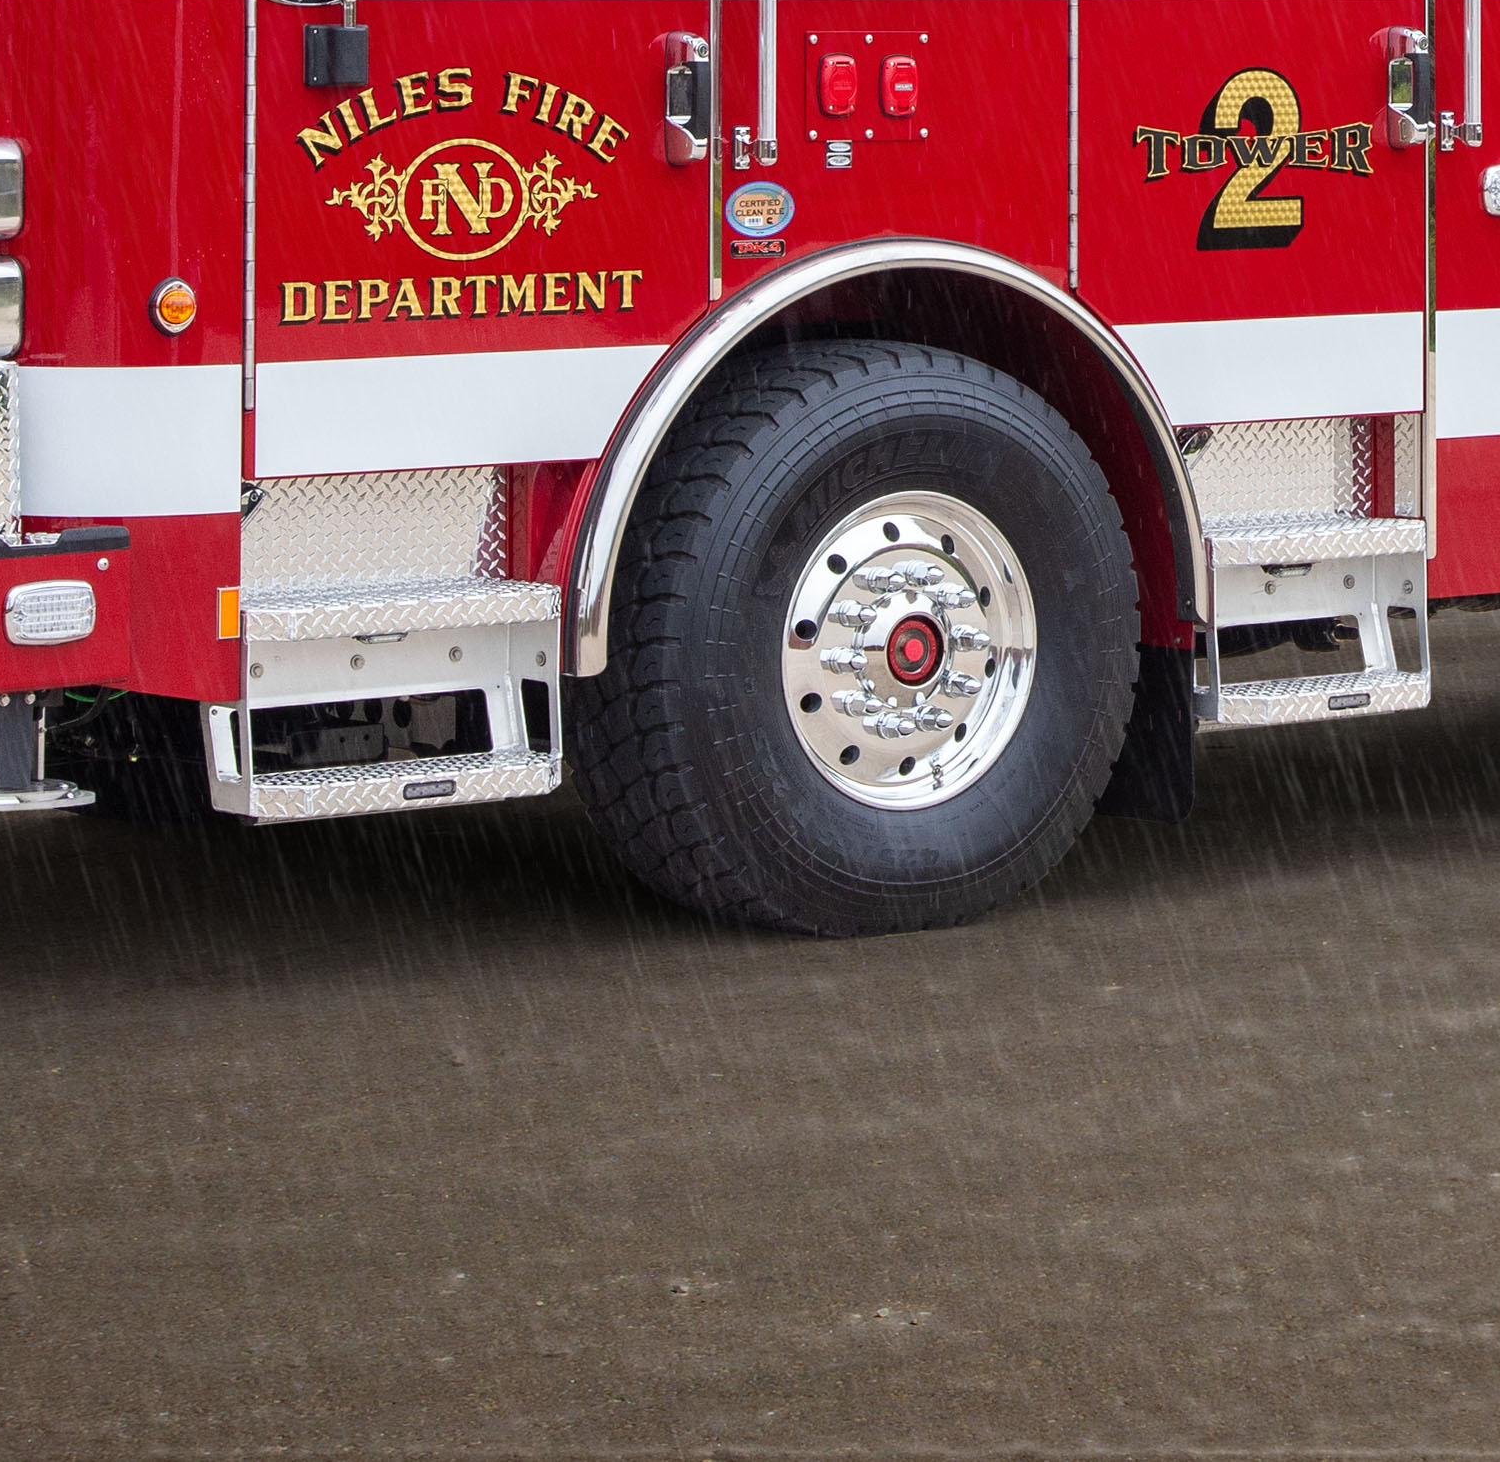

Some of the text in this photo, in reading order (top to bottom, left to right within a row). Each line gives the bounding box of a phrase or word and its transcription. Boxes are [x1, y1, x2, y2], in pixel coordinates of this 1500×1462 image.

[295, 66, 631, 173] NILES FIRE
[1132, 121, 1375, 184] TOWER
[1196, 65, 1305, 252] 2
[735, 208, 785, 217] CLEAN IDLE
[739, 199, 781, 208] CERTIFIED
[279, 270, 643, 325] DEPARTMENT
